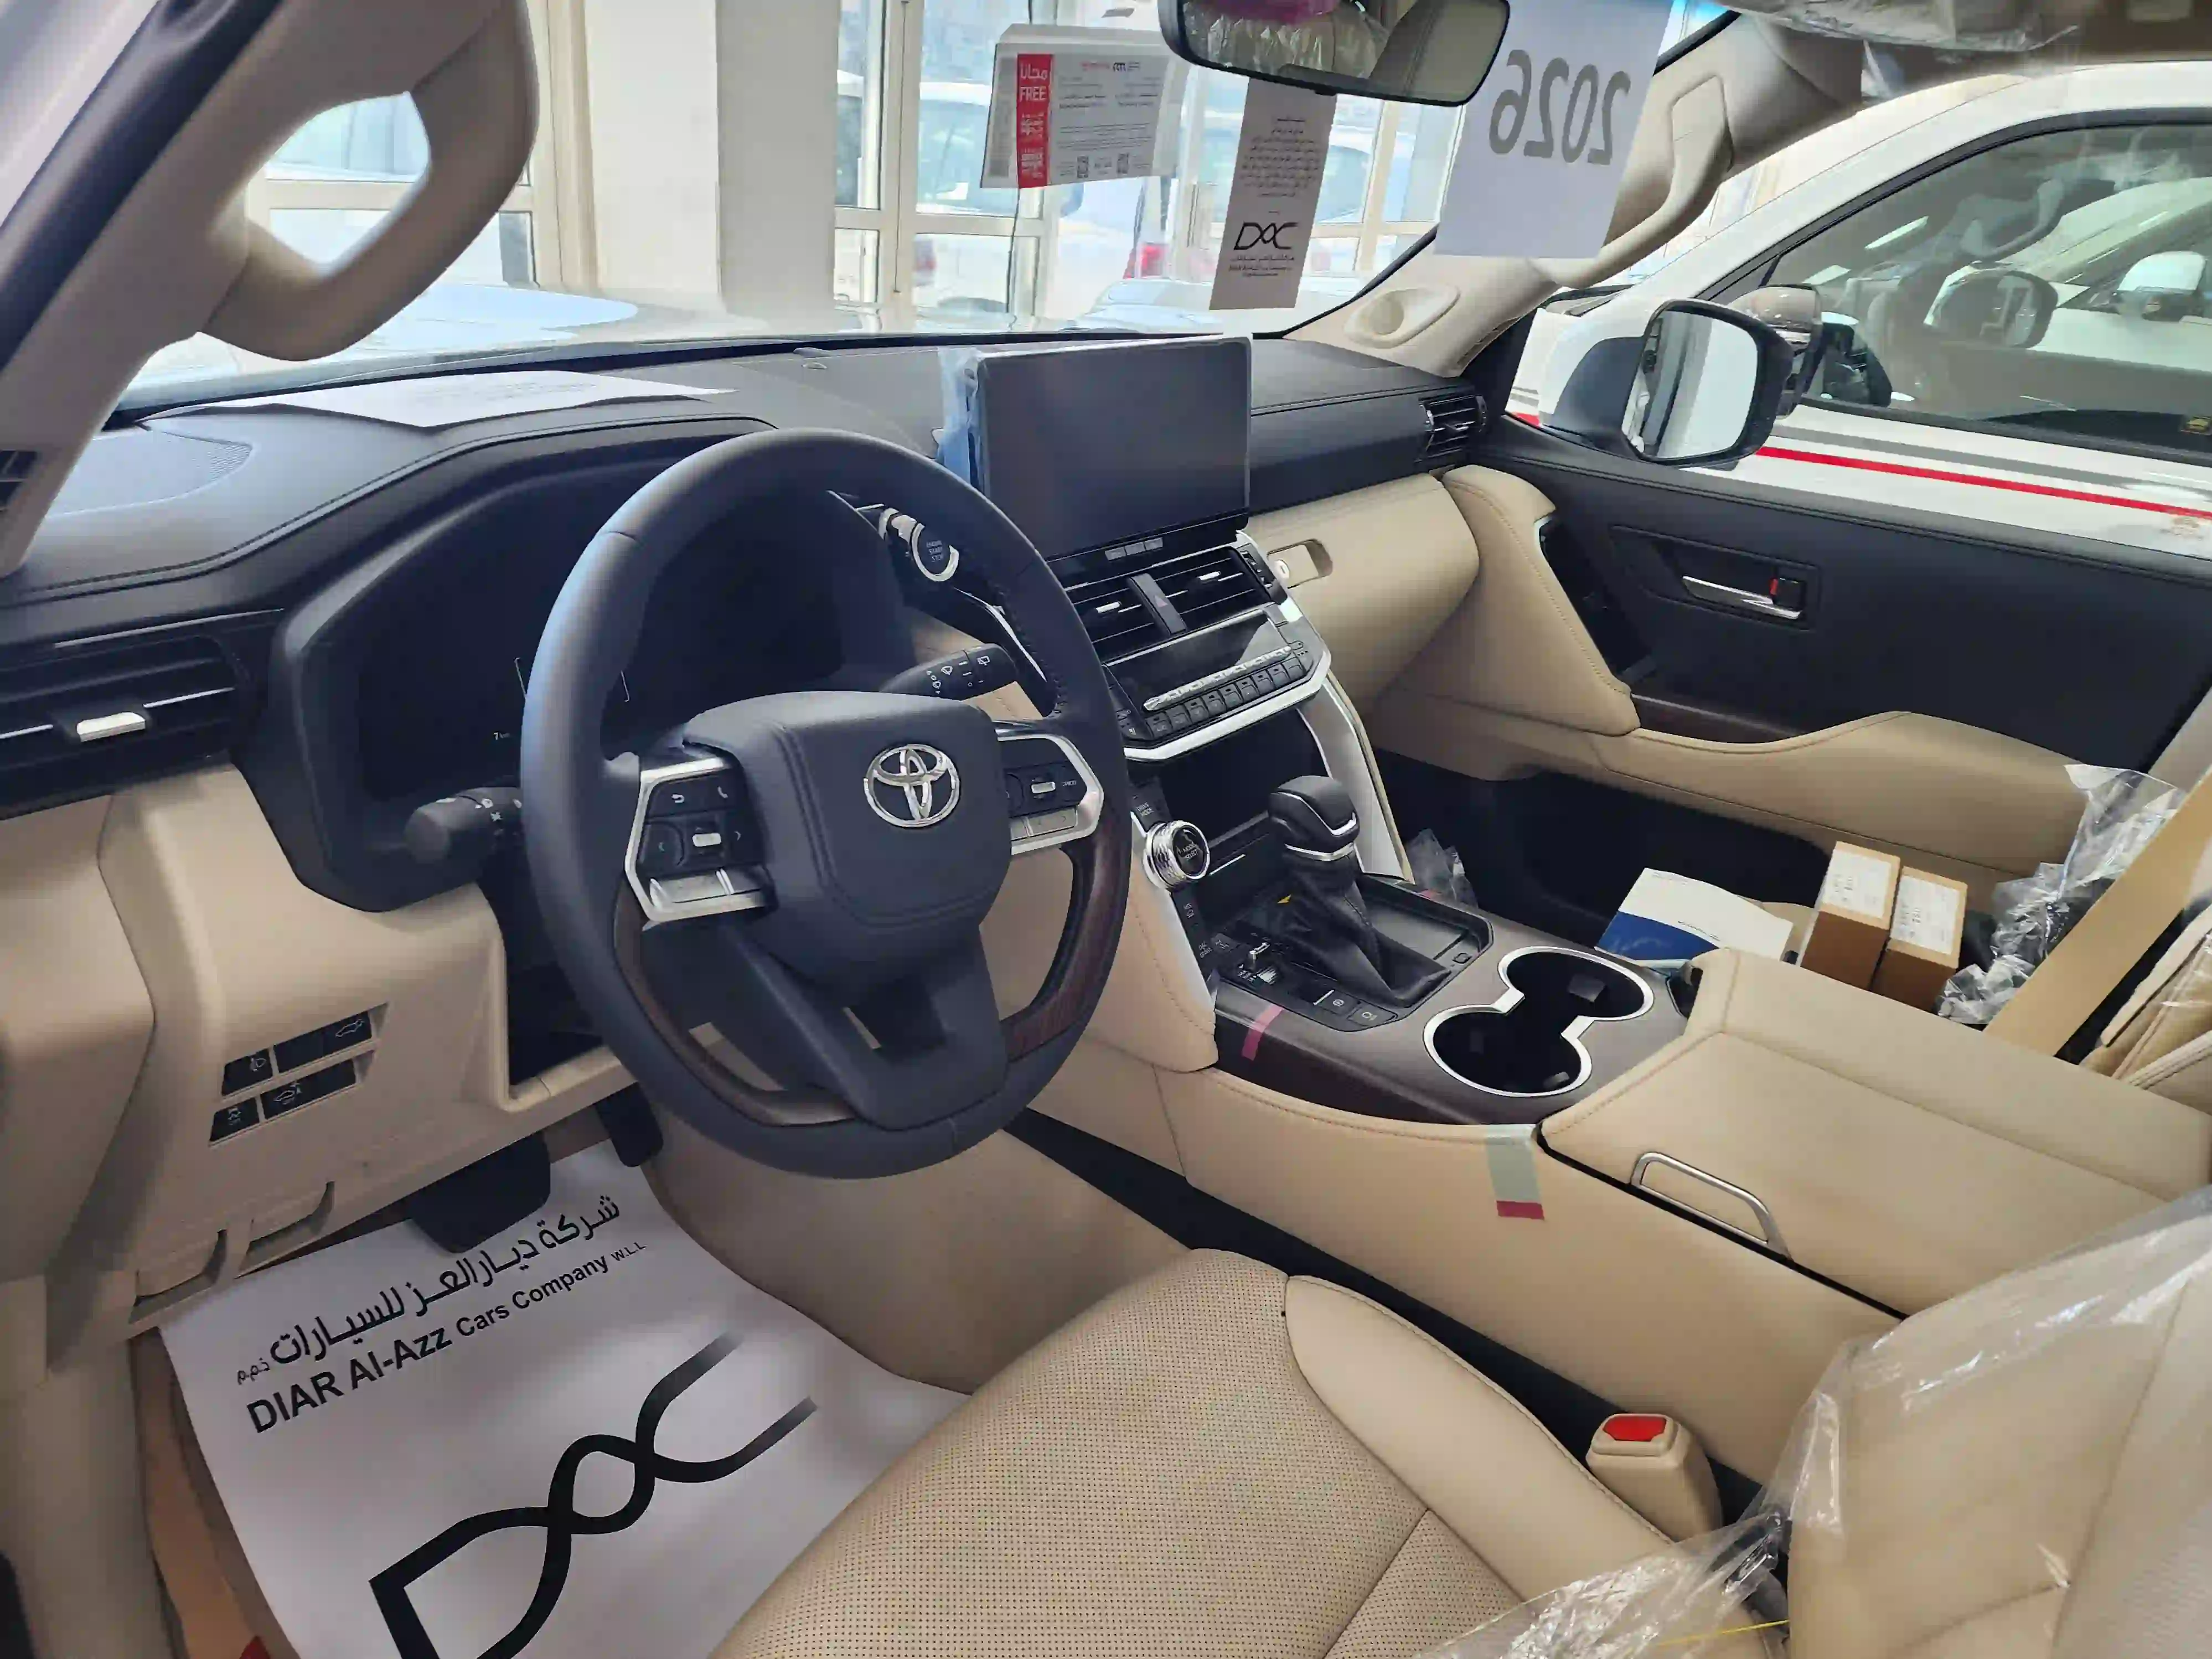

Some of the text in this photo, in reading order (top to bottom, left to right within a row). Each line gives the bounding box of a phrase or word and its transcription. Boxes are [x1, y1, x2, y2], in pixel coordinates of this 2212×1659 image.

[1019, 86, 1047, 102] FREE
[536, 1195, 619, 1248] شركة
[405, 1257, 478, 1316] العز
[478, 1239, 540, 1287] ديار
[247, 1371, 345, 1433] DIAR
[350, 1327, 452, 1390] Al-Azz
[456, 1304, 510, 1336] Cars
[512, 1255, 608, 1309] Company
[270, 1286, 405, 1364] للسيارات
